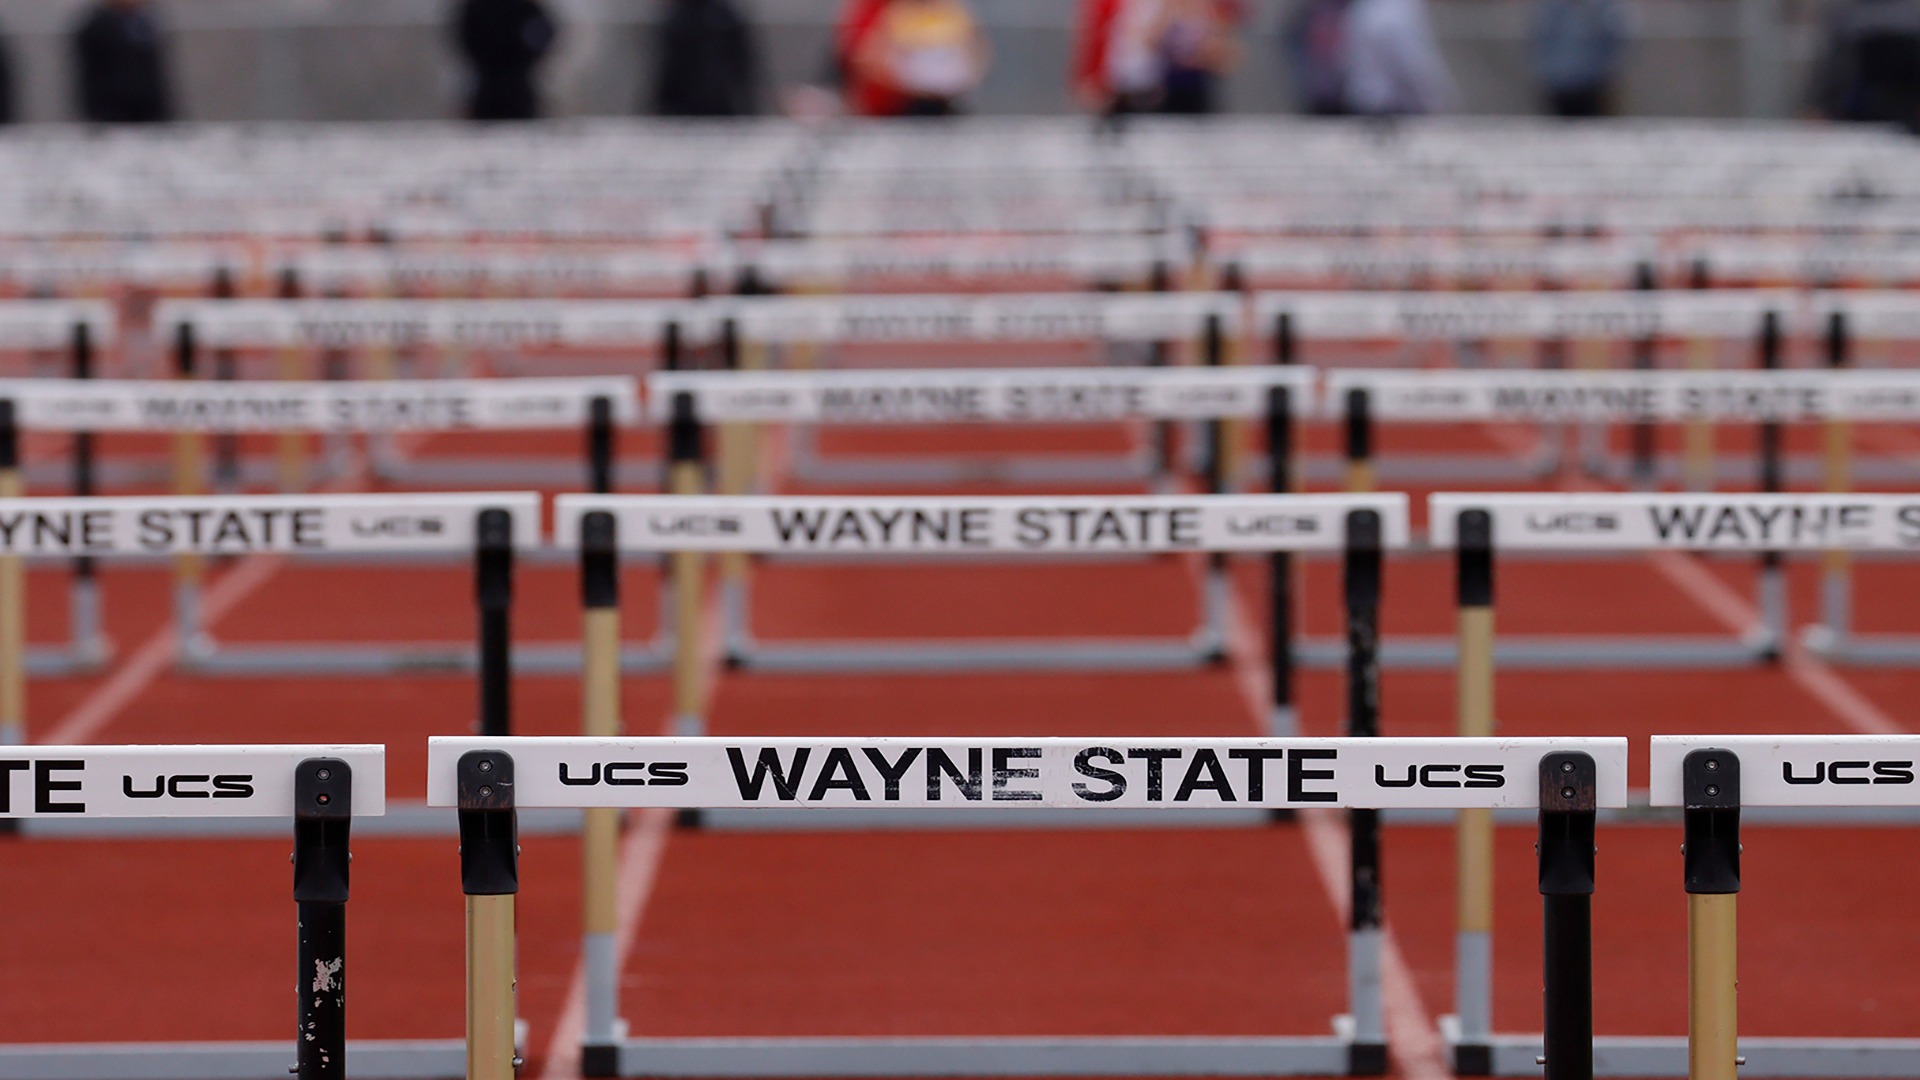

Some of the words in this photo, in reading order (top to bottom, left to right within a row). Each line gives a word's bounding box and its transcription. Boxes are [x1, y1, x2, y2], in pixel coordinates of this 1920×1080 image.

[138, 509, 327, 549] STATE
[351, 517, 446, 536] UCS
[649, 515, 743, 535] UCS
[771, 507, 993, 545] WAYNE
[1014, 507, 1202, 545] STATE
[1227, 515, 1321, 535] UCS
[1527, 513, 1620, 532] UCS
[1649, 505, 1874, 541] WAYNE
[123, 775, 254, 798] UCS
[558, 763, 689, 785] UCS
[726, 748, 1043, 802] WAYNE
[1071, 747, 1337, 803] STATE
[1374, 765, 1505, 788] UCS
[1783, 761, 1914, 784] UCS
